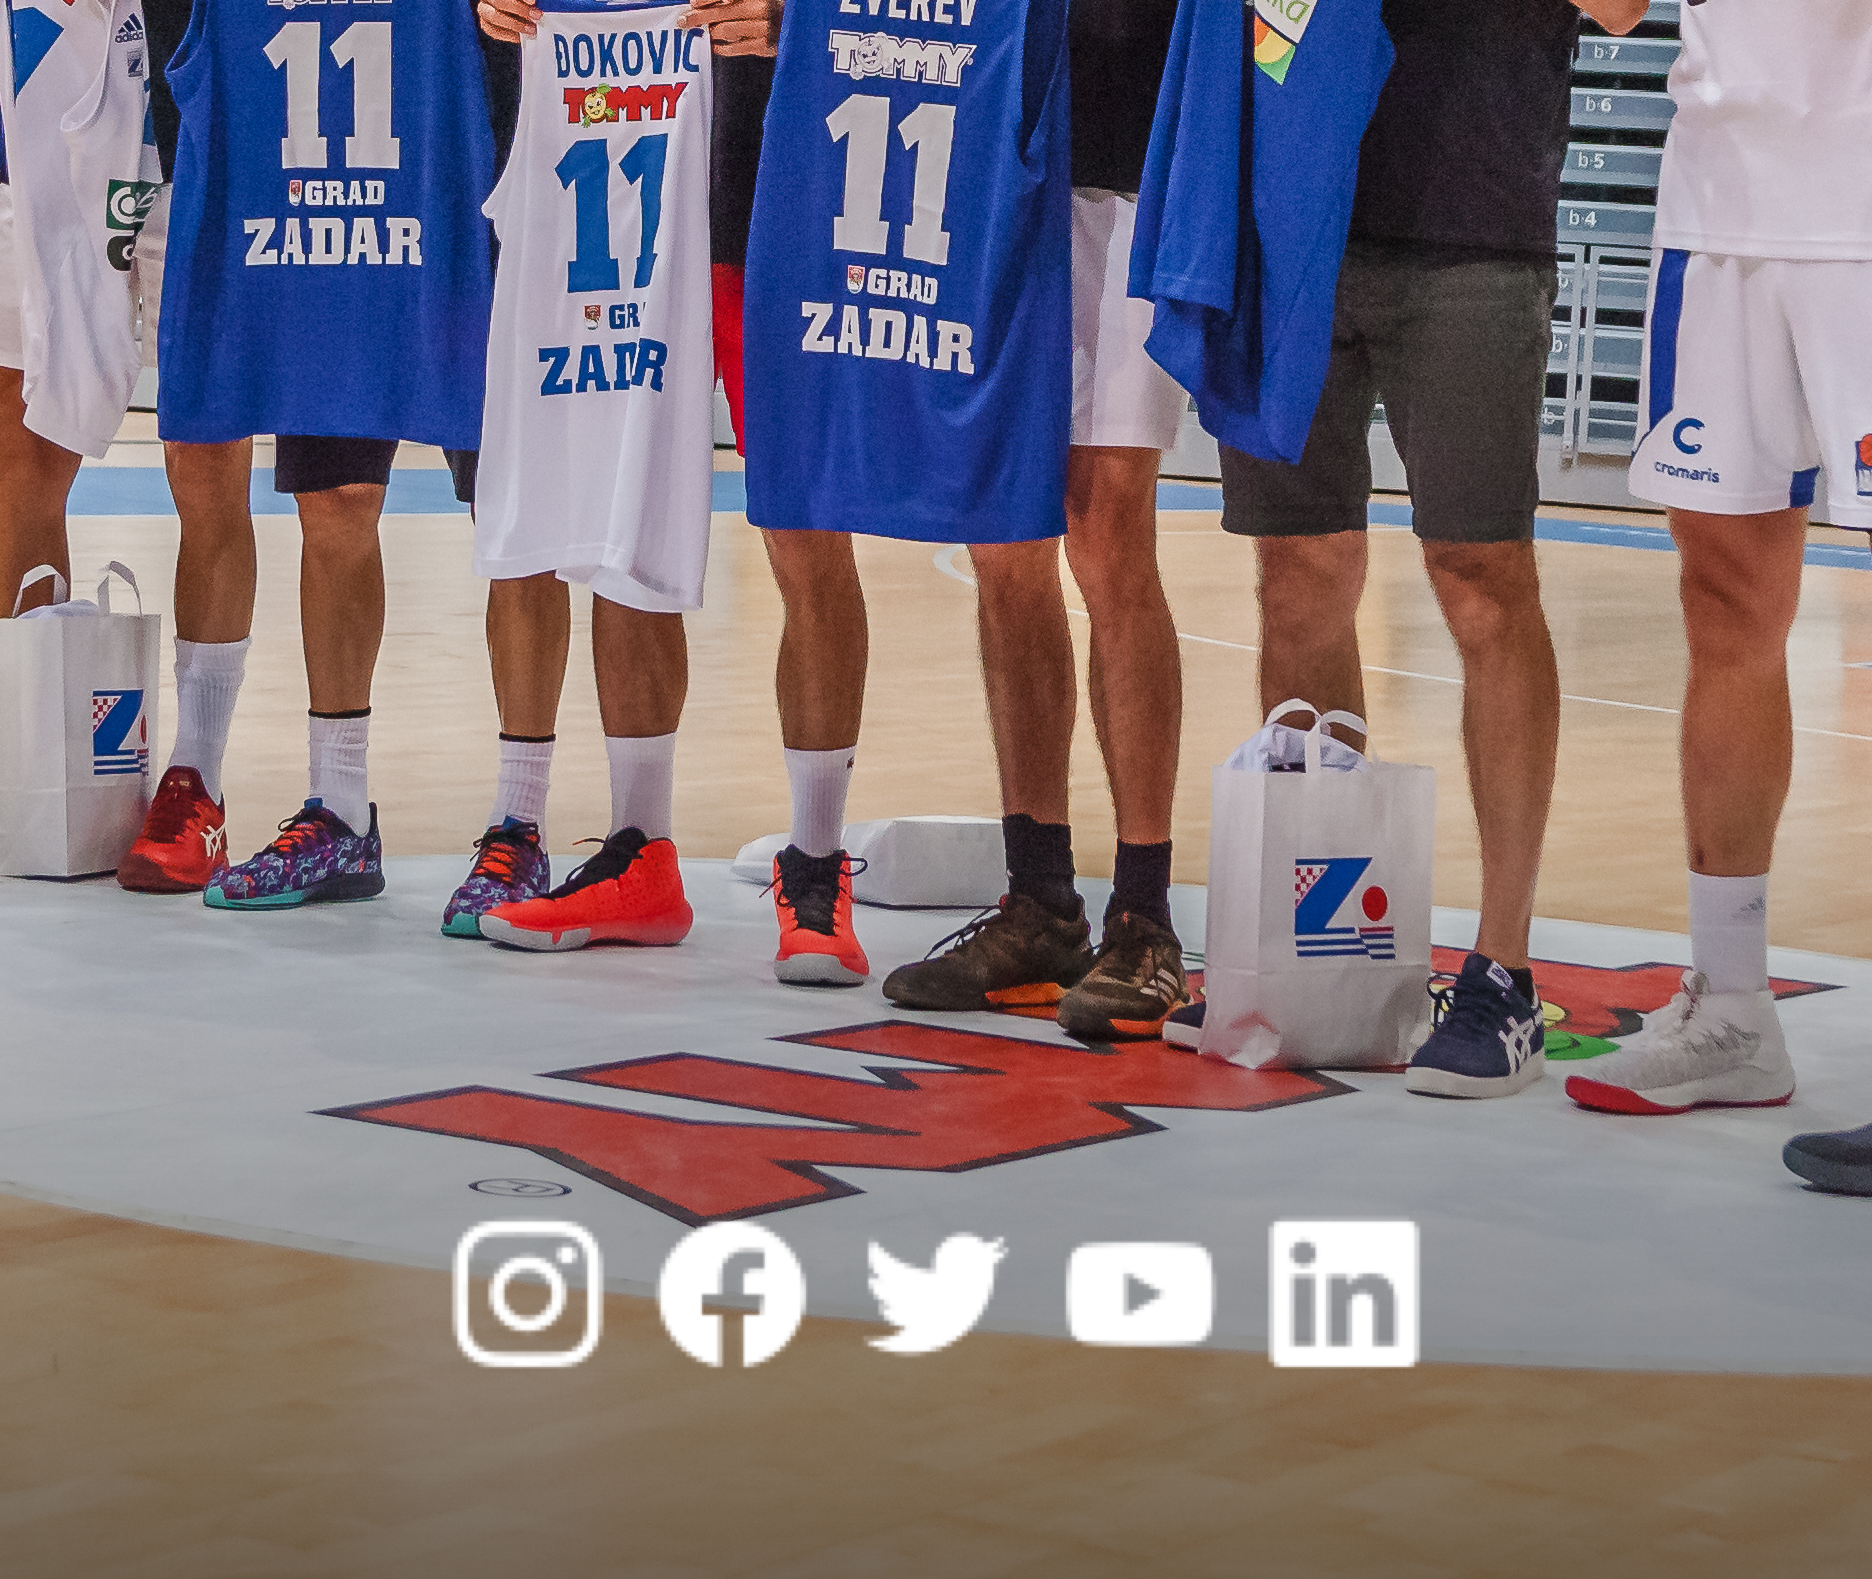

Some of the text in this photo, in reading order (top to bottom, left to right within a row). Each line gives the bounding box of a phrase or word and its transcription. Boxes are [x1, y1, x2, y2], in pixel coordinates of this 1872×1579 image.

[828, 29, 978, 89] TOMMY
[263, 21, 401, 170] 11
[562, 81, 689, 128] TOMMY
[304, 179, 386, 207] GRAD
[825, 93, 958, 267] 11
[554, 133, 669, 294] 11
[243, 217, 424, 267] ZADAR
[866, 267, 939, 305] GRAD
[800, 300, 976, 376] ZADAR
[1653, 460, 1721, 484] cromaris
